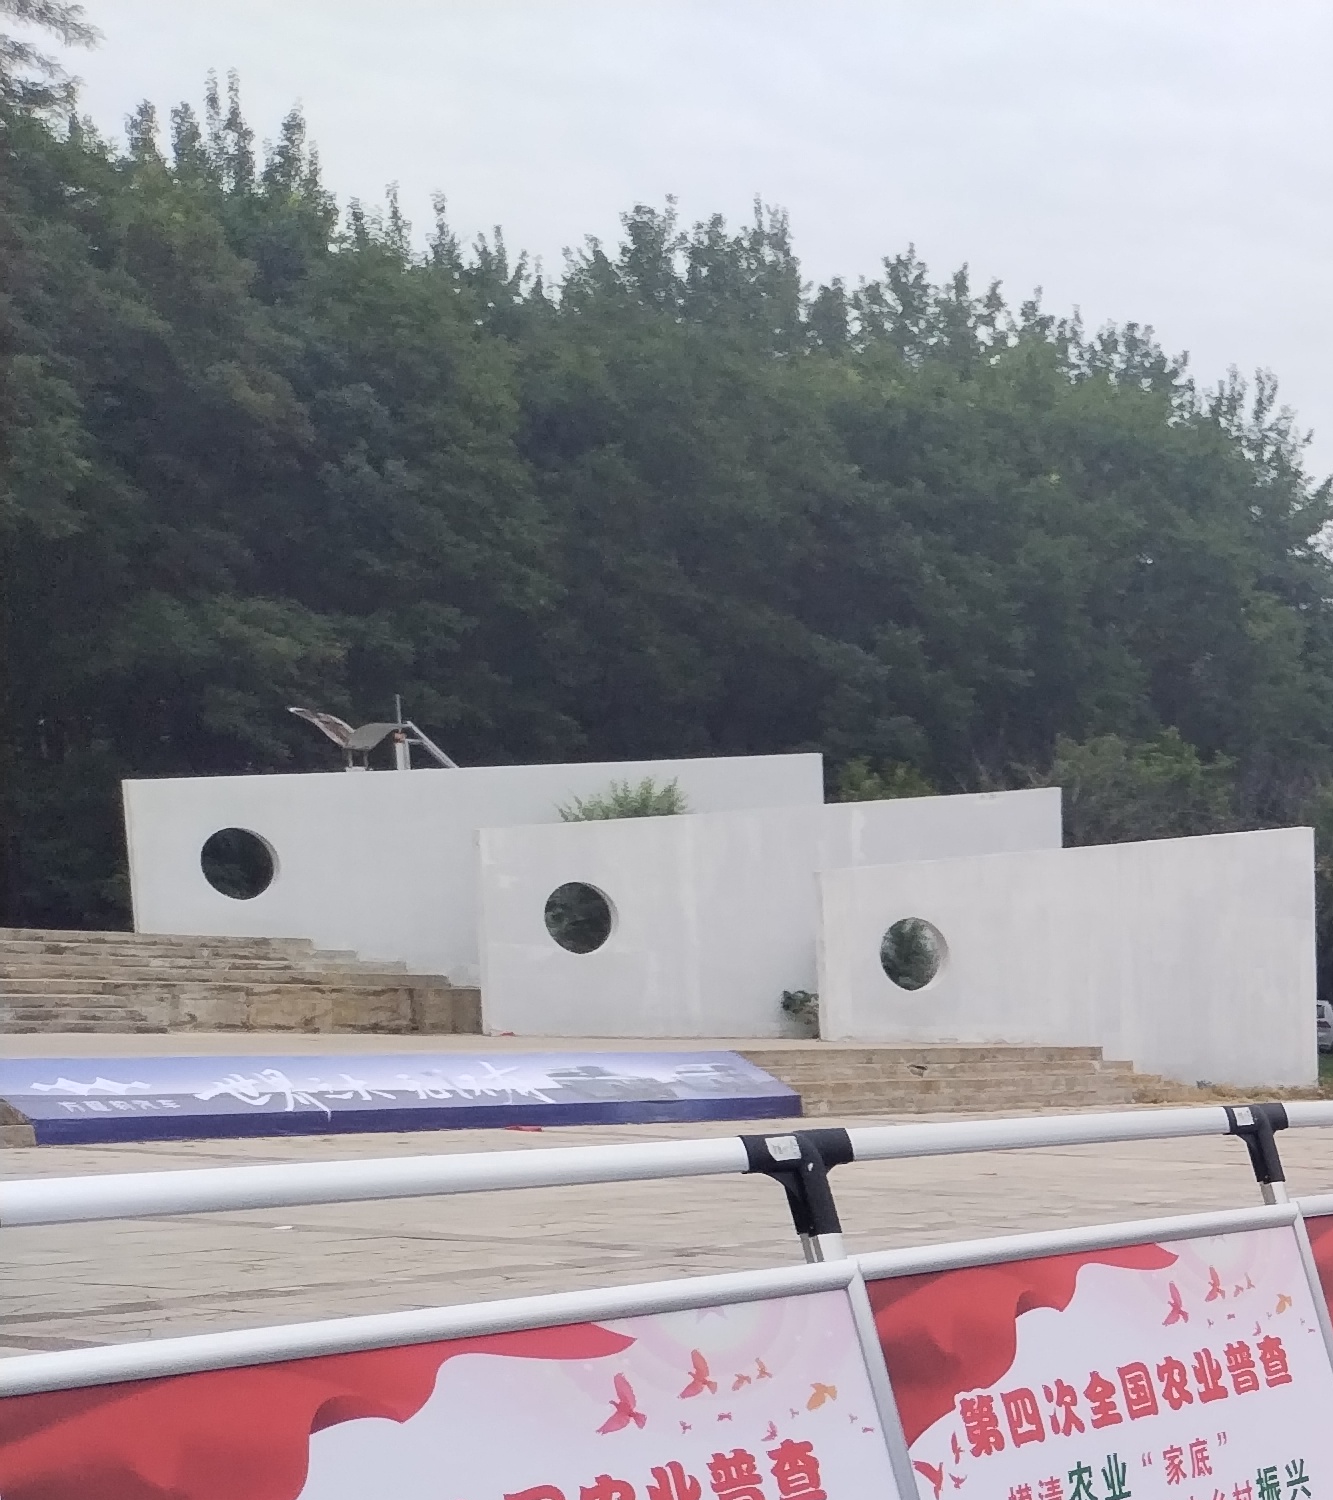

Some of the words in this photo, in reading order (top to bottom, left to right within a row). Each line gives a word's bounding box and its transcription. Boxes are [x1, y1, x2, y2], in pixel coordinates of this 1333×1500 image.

[960, 1335, 1293, 1458] 第四次全国农业普查
